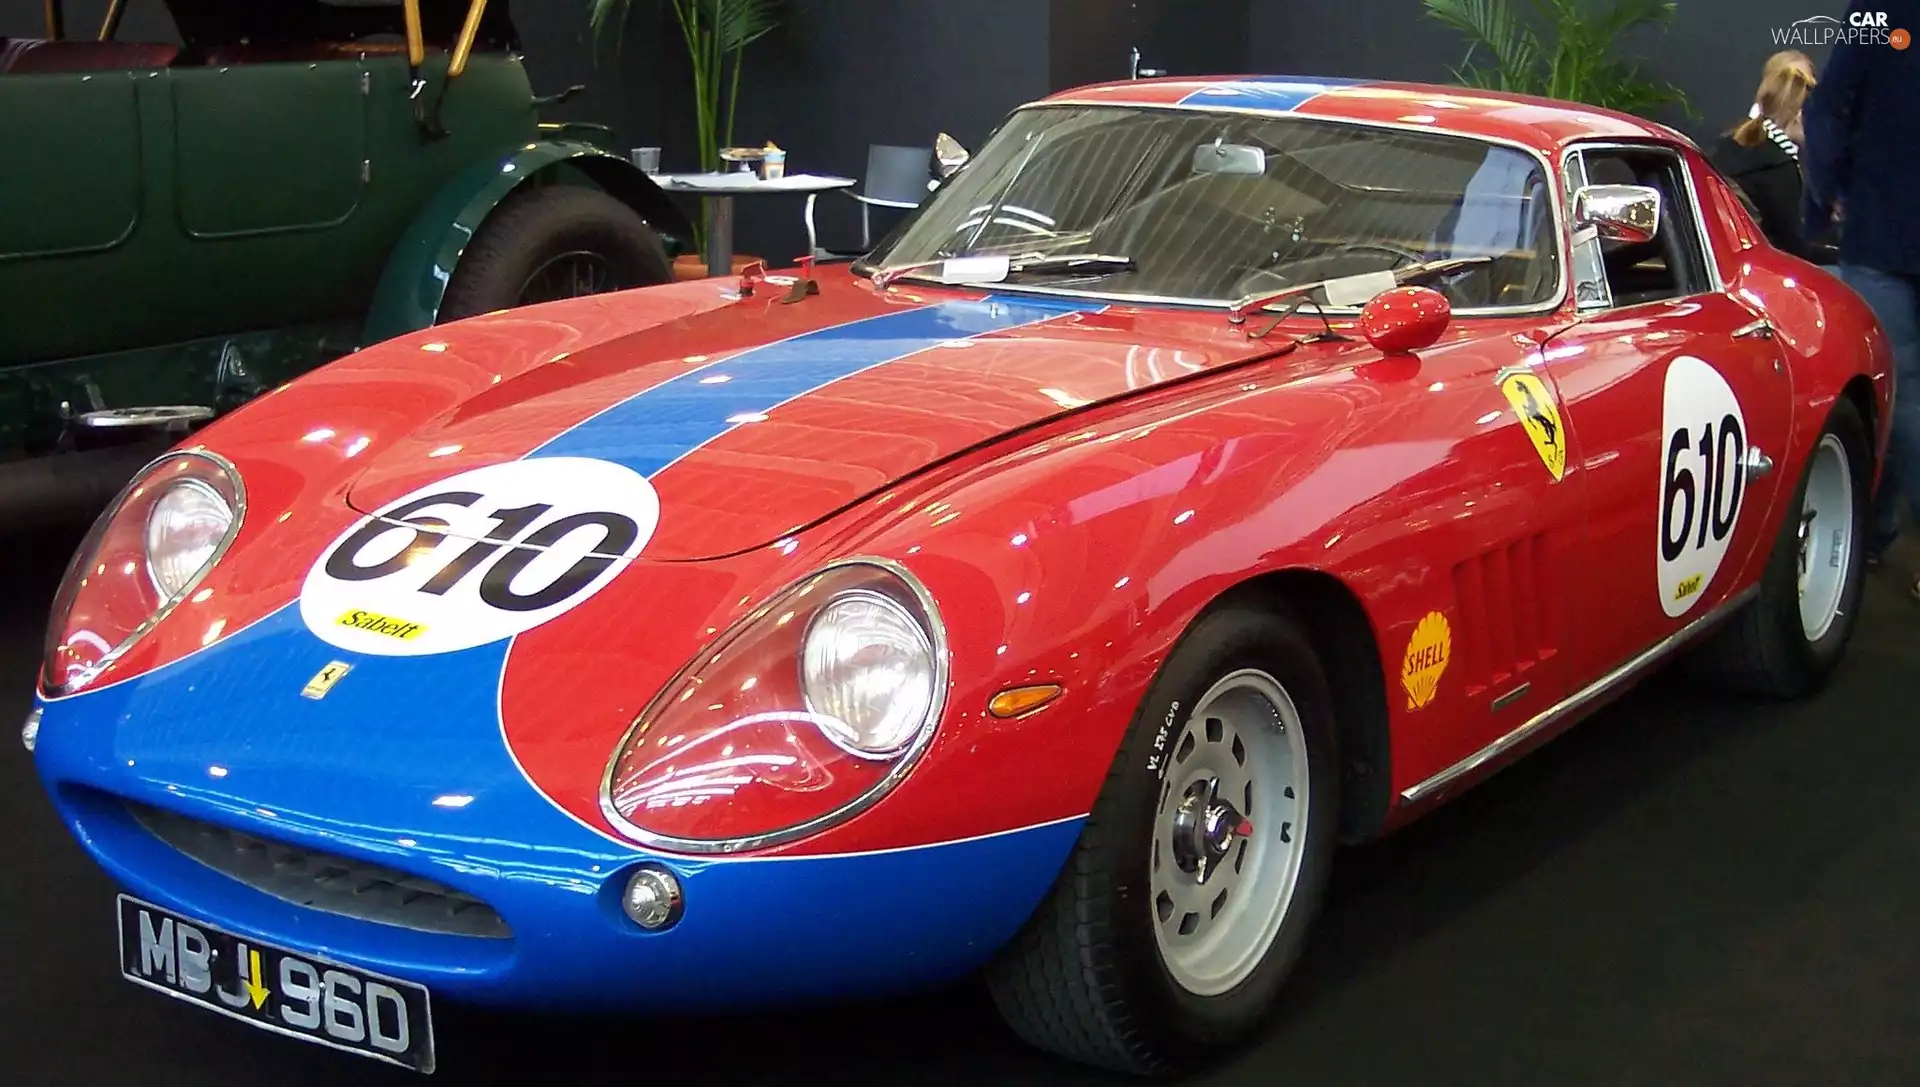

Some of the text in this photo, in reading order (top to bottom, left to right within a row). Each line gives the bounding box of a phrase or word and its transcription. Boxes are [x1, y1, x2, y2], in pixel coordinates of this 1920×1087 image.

[1662, 413, 1744, 562] 610
[325, 491, 638, 612] 610
[342, 611, 419, 638] Sabelt
[1407, 641, 1445, 676] SHELL
[1153, 725, 1168, 751] 275
[138, 909, 410, 1054] MBJ 96D
